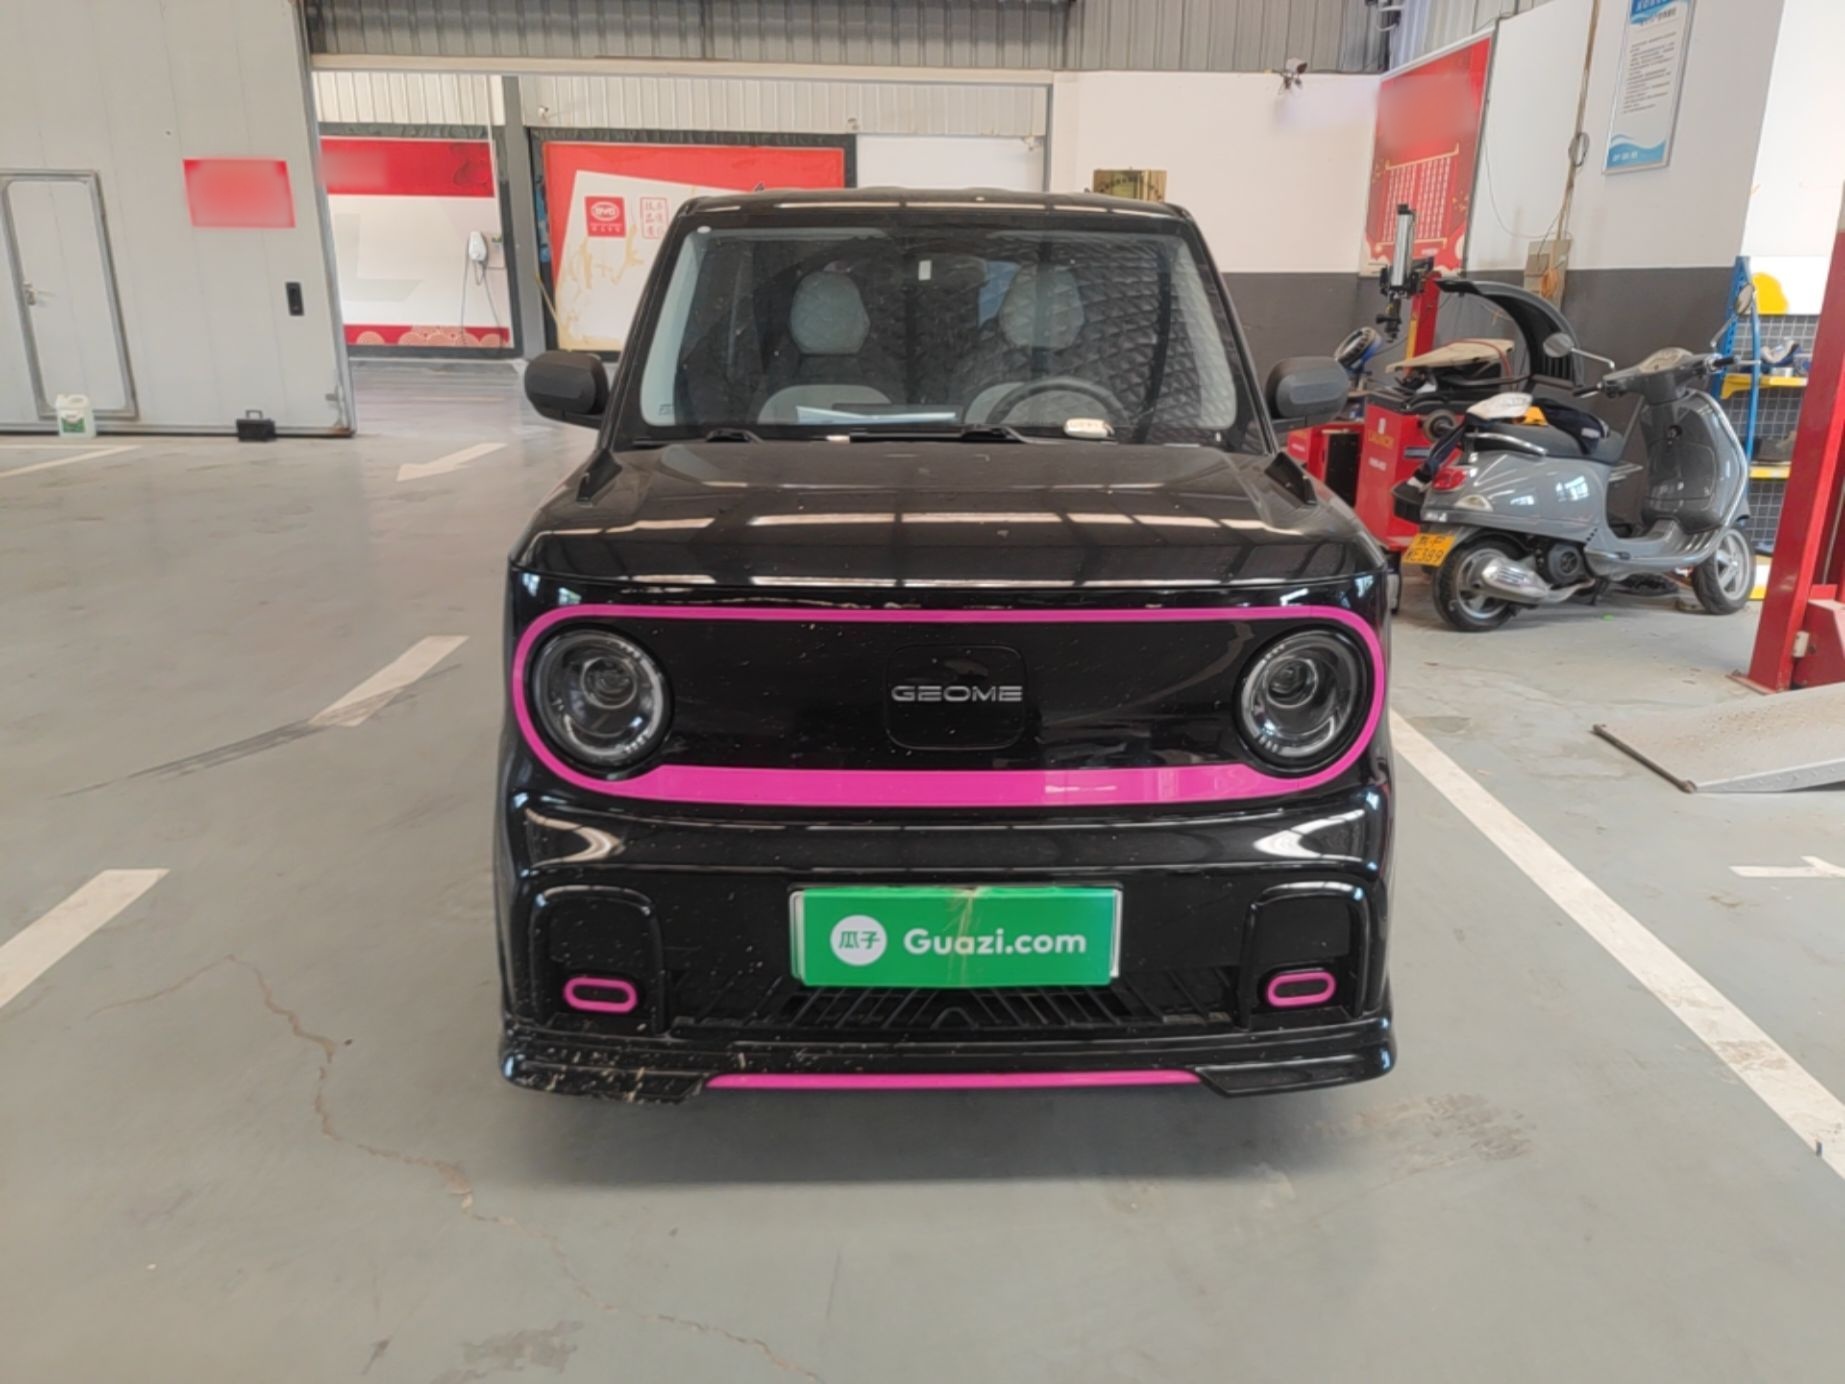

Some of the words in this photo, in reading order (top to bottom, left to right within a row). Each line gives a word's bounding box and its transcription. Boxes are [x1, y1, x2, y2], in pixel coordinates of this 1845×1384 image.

[593, 204, 617, 218] BYD
[891, 685, 1023, 702] GEOME
[839, 930, 880, 950] 瓜子
[903, 928, 1086, 955] Guazi.com
